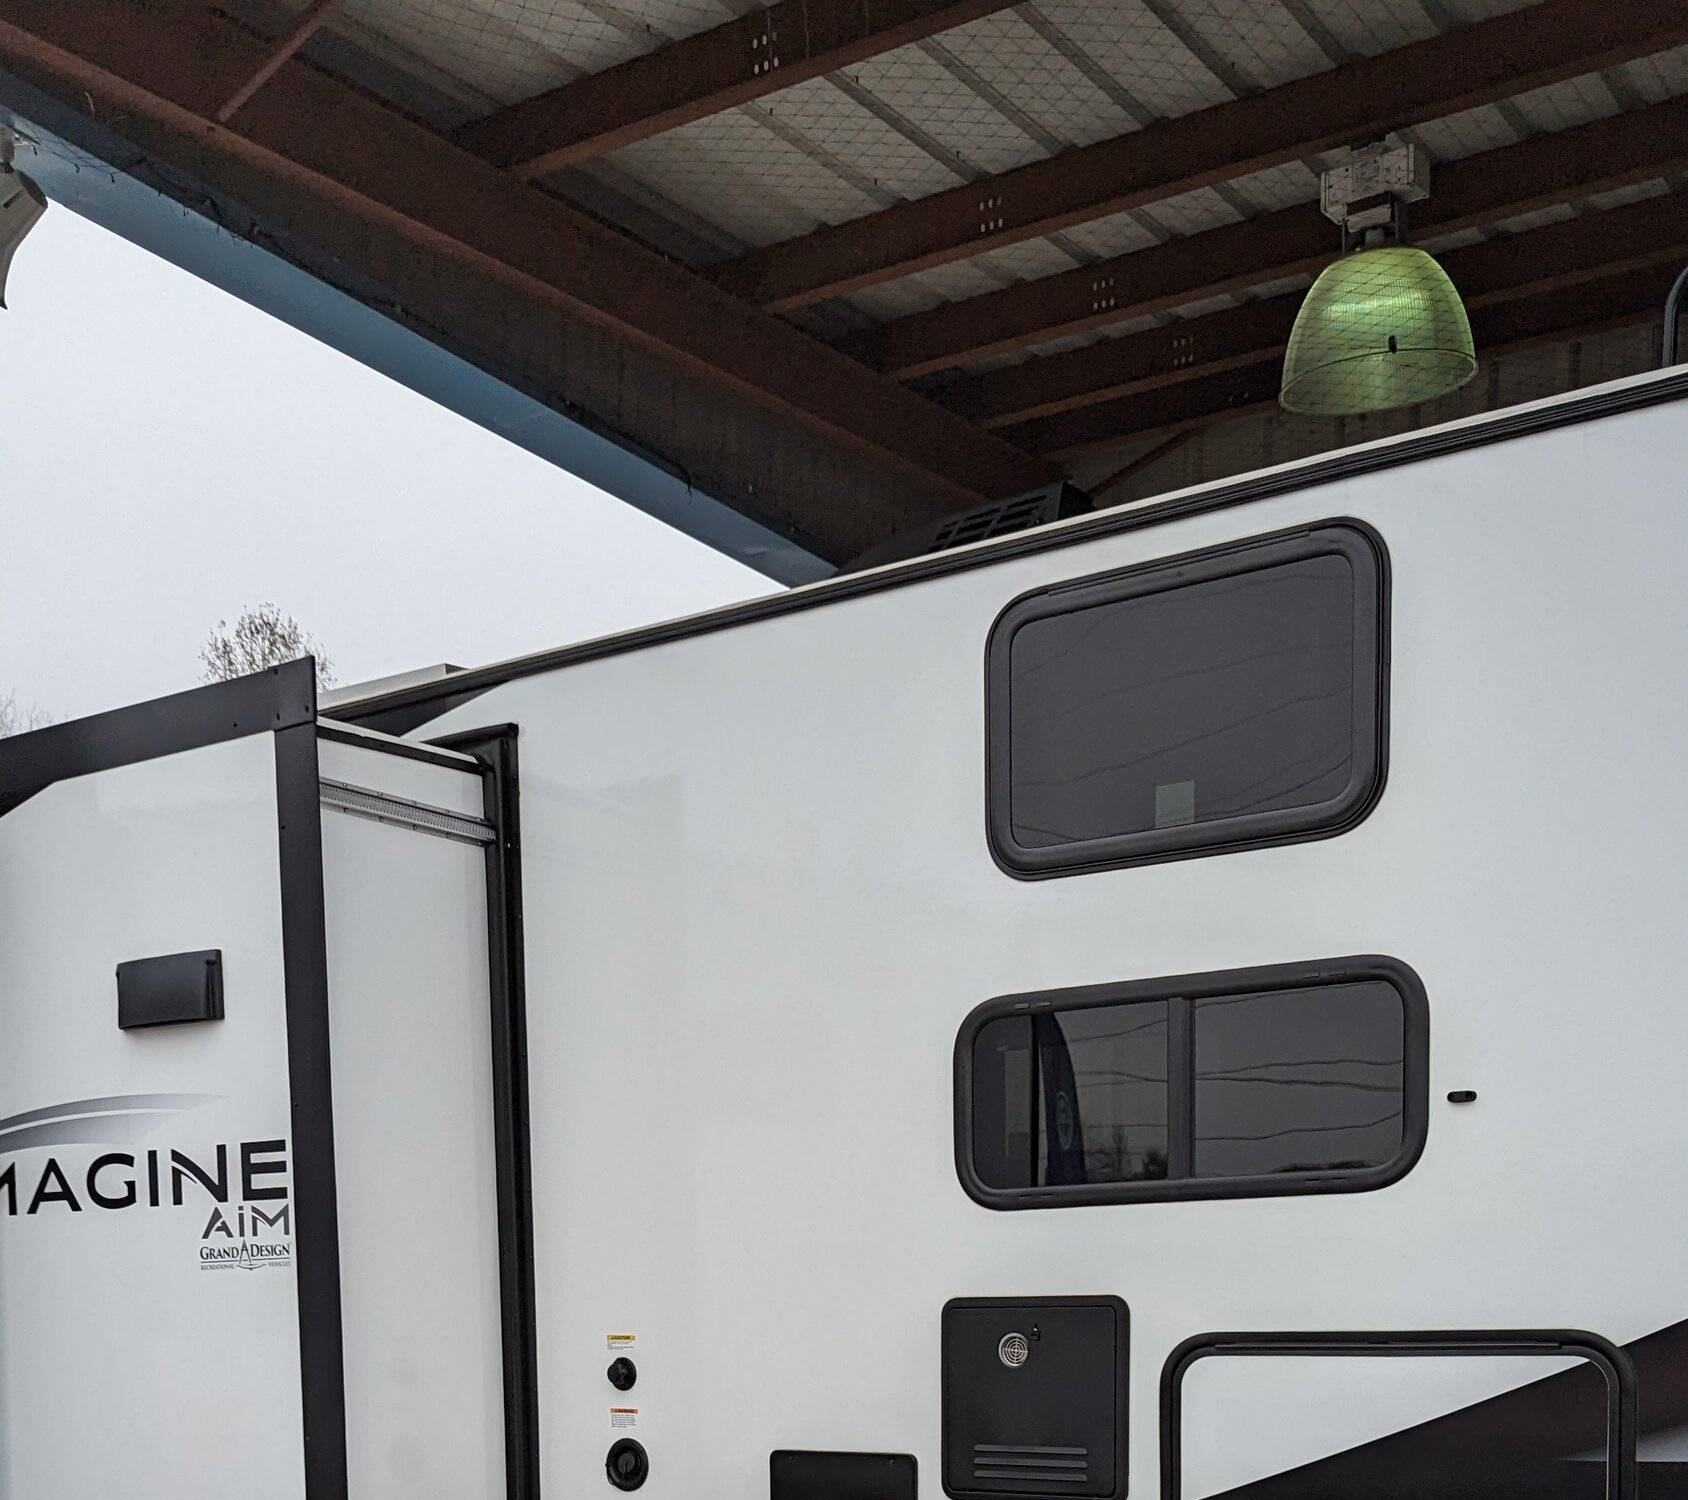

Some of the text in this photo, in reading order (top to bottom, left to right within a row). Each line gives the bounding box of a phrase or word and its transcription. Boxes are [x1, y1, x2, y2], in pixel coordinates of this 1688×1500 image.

[0, 1139, 288, 1216] AGINE
[200, 1243, 290, 1260] GRAND DESIGN
